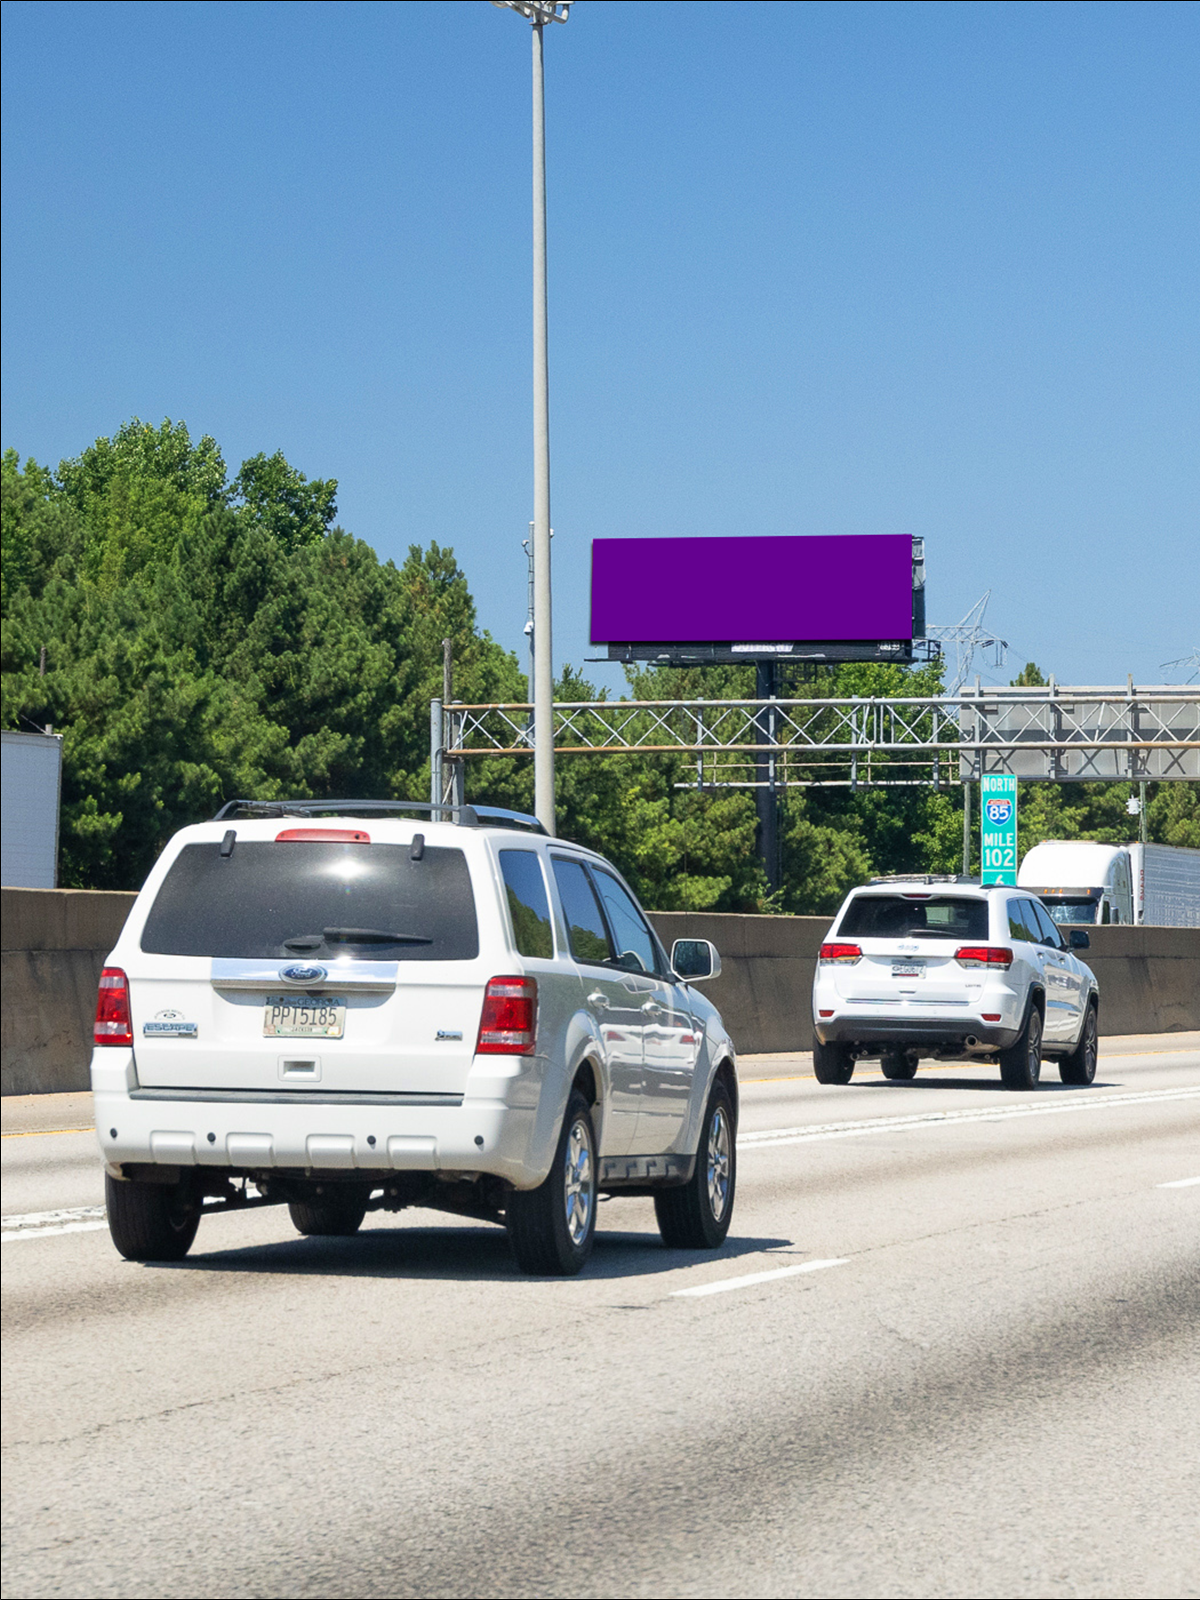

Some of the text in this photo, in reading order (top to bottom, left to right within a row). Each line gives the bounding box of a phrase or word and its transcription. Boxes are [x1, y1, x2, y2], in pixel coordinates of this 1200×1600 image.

[983, 777, 1015, 792] NORTH
[989, 806, 1009, 820] 85
[984, 833, 1014, 847] MILE
[985, 849, 1014, 867] 102
[995, 874, 1004, 885] 6
[271, 1006, 337, 1026] PPT5185
[146, 1023, 194, 1032] ESCAPE
